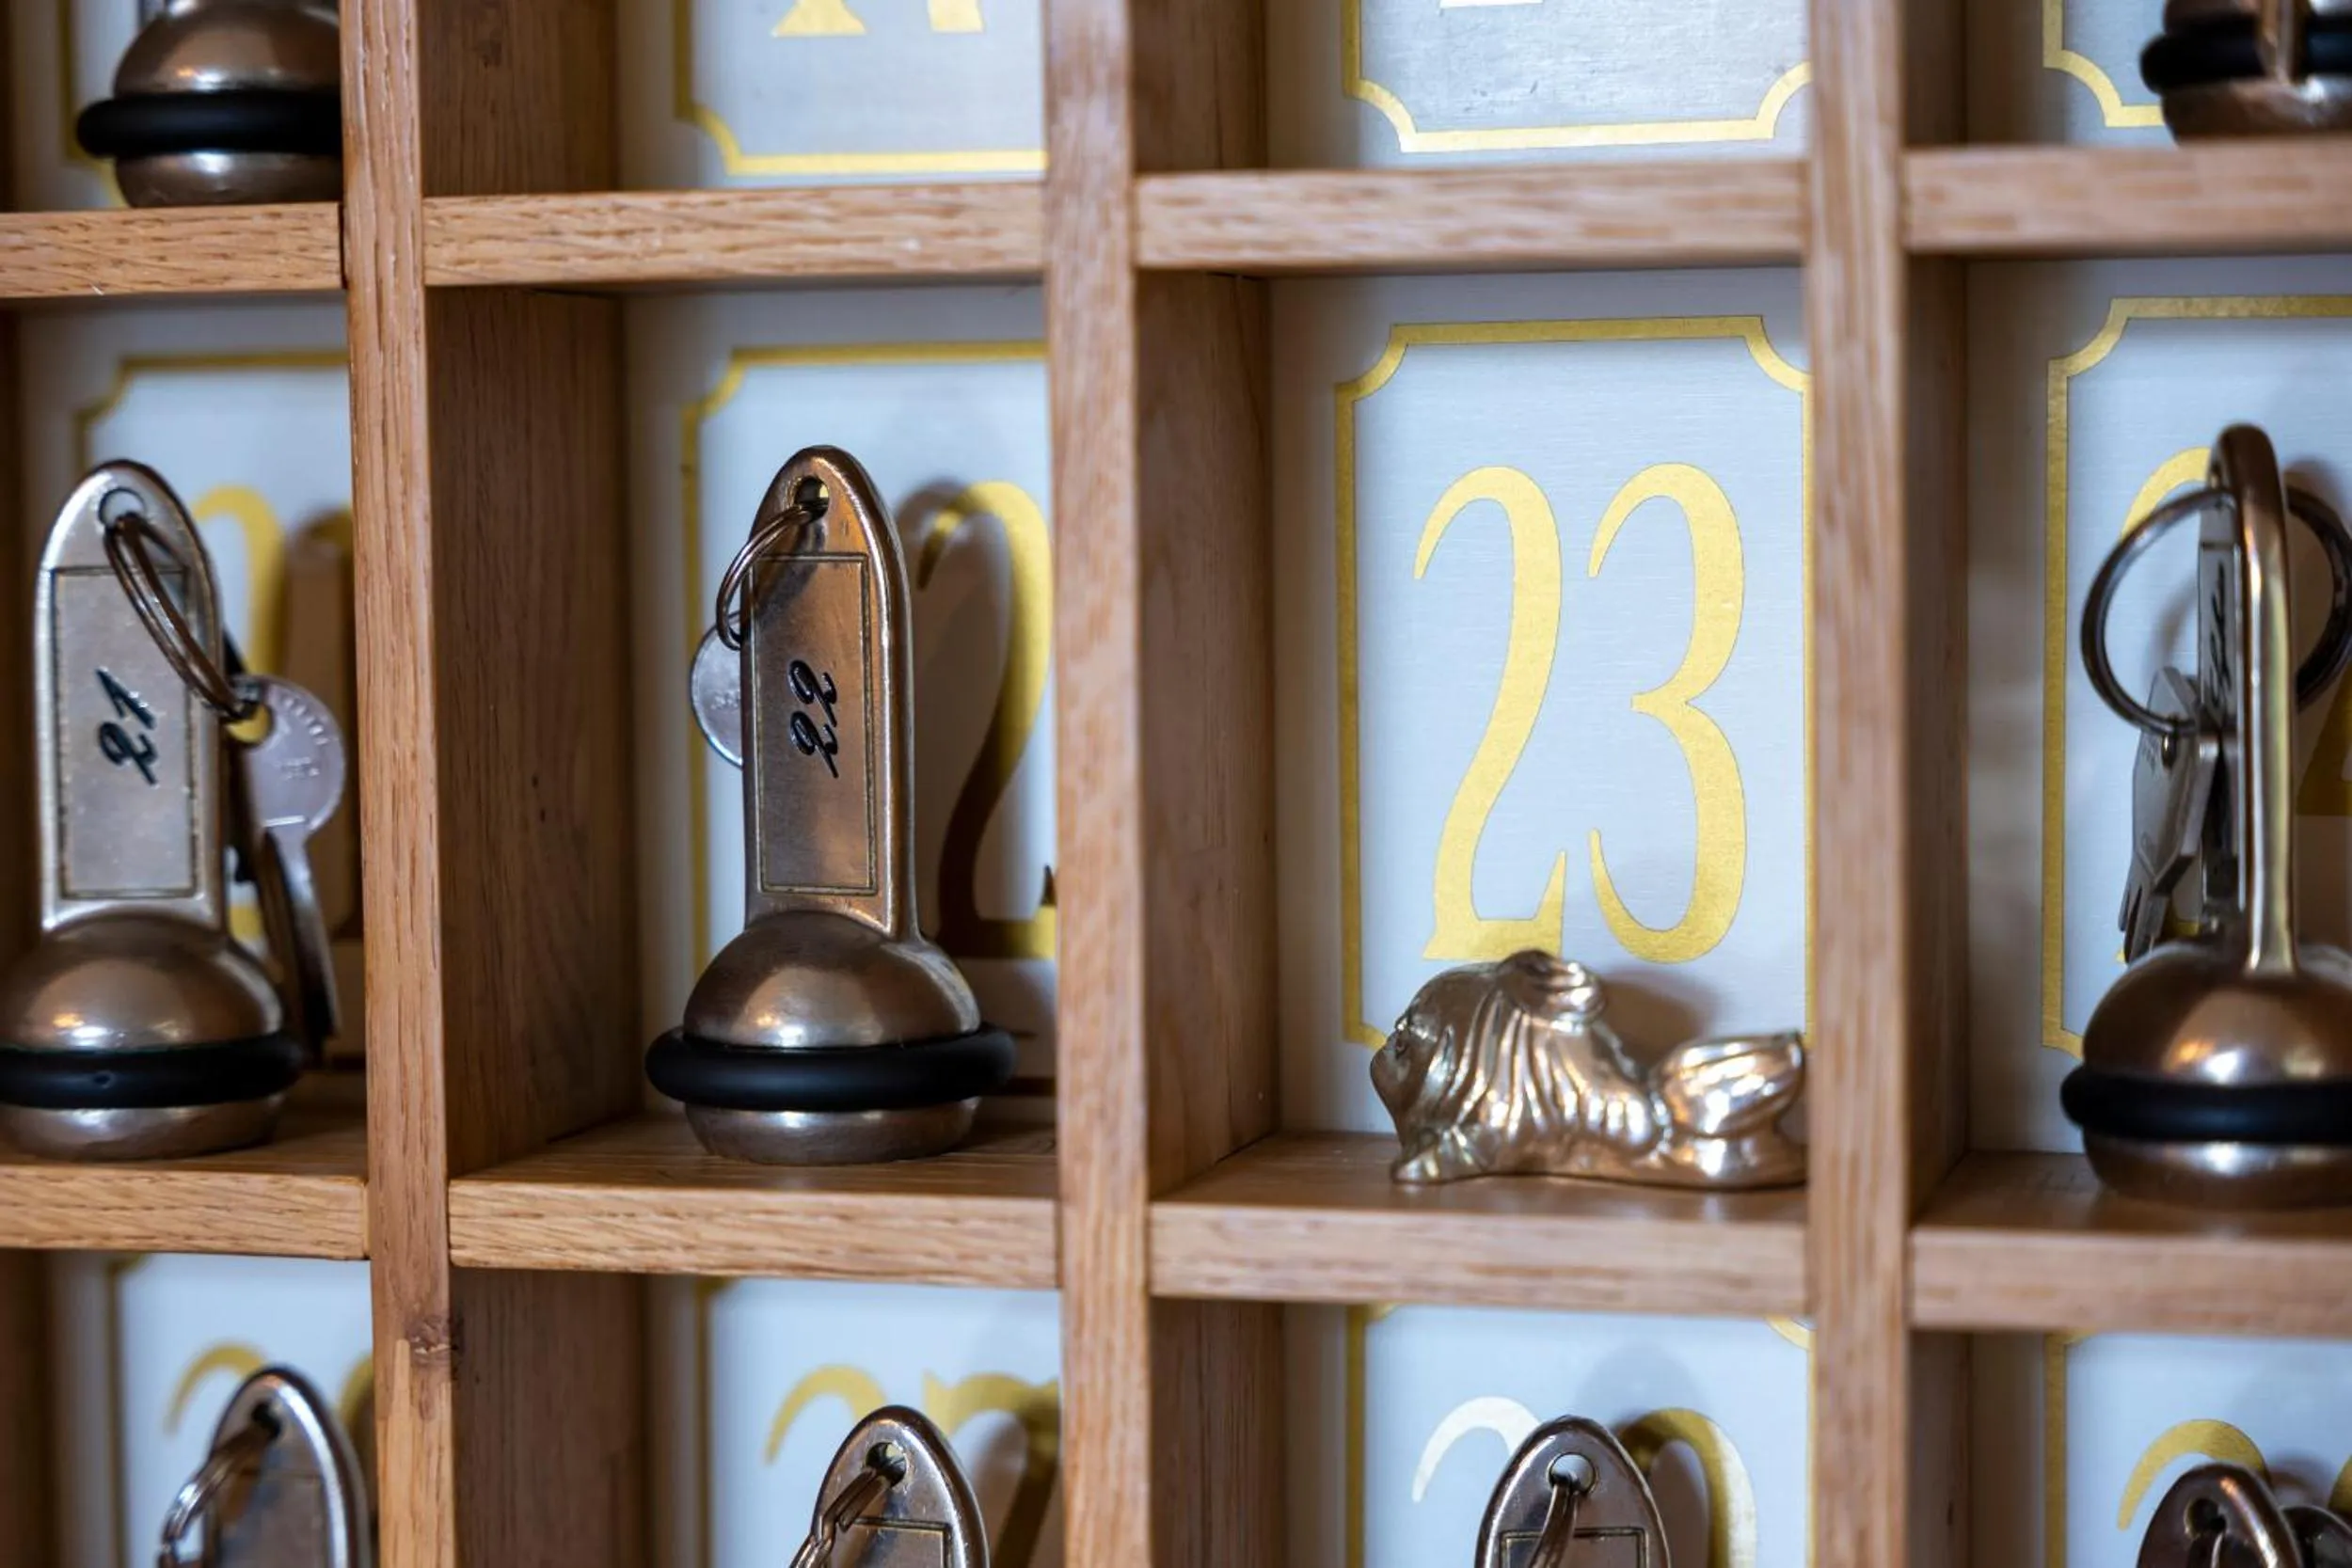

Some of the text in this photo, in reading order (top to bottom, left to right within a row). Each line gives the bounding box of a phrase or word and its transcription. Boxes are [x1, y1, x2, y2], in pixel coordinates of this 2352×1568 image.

[96, 668, 158, 786] 21
[788, 659, 839, 779] 22
[1414, 462, 1746, 964] 23
